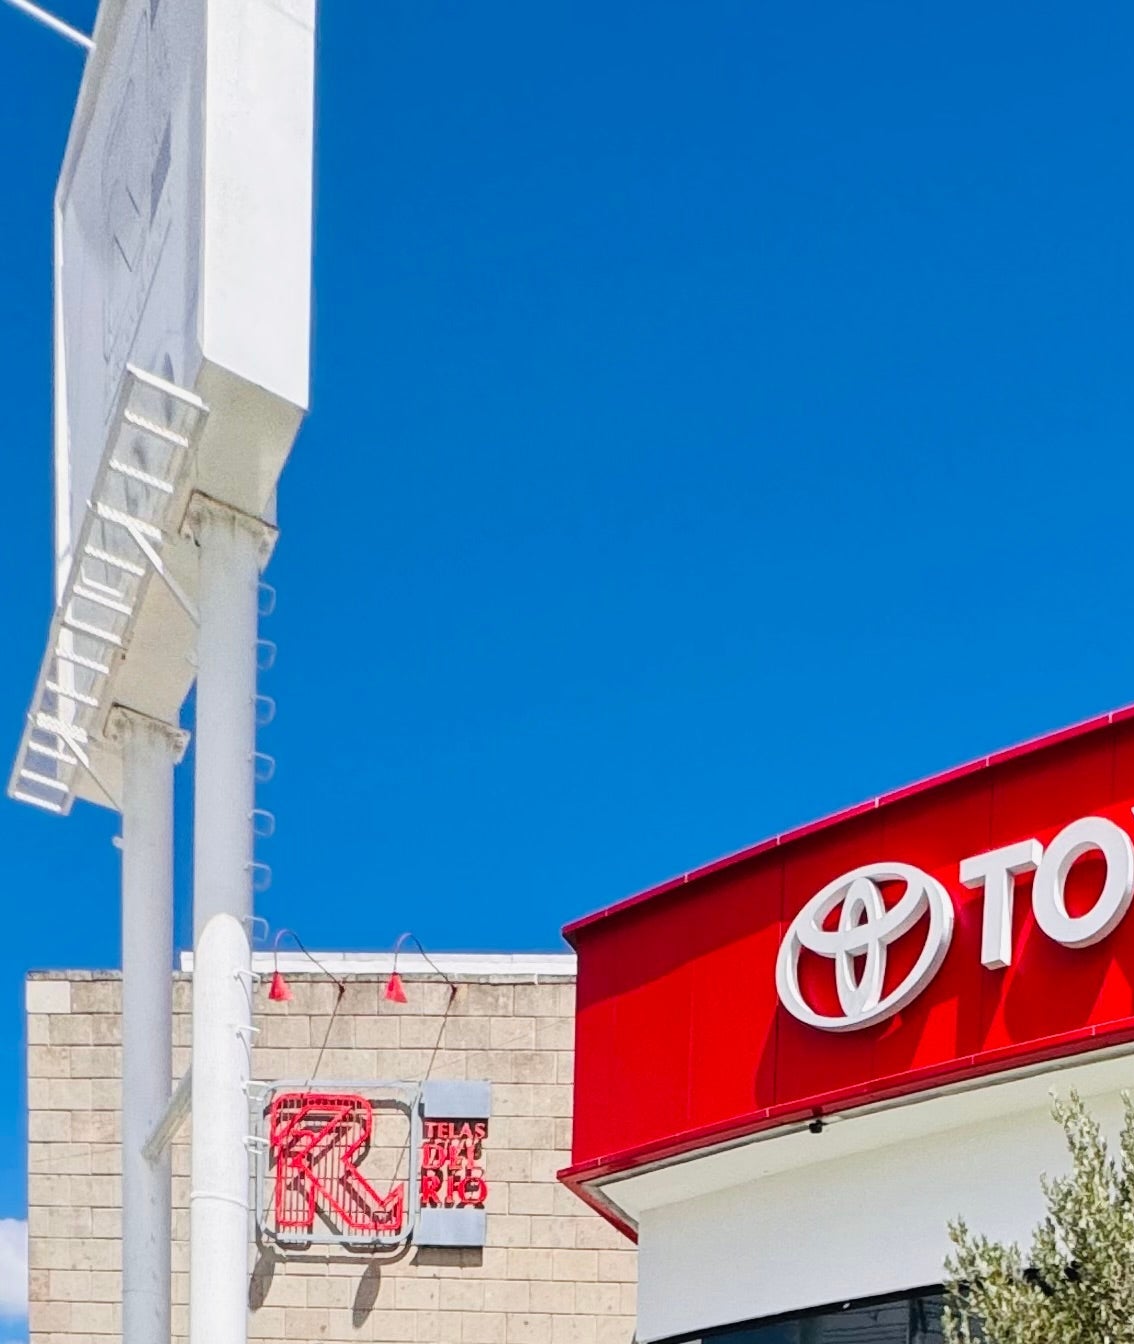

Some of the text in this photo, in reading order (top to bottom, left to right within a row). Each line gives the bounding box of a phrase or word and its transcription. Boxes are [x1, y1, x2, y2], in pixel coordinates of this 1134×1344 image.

[423, 1121, 486, 1139] TELAS
[421, 1141, 476, 1170] DEL
[420, 1174, 488, 1205] RIO
